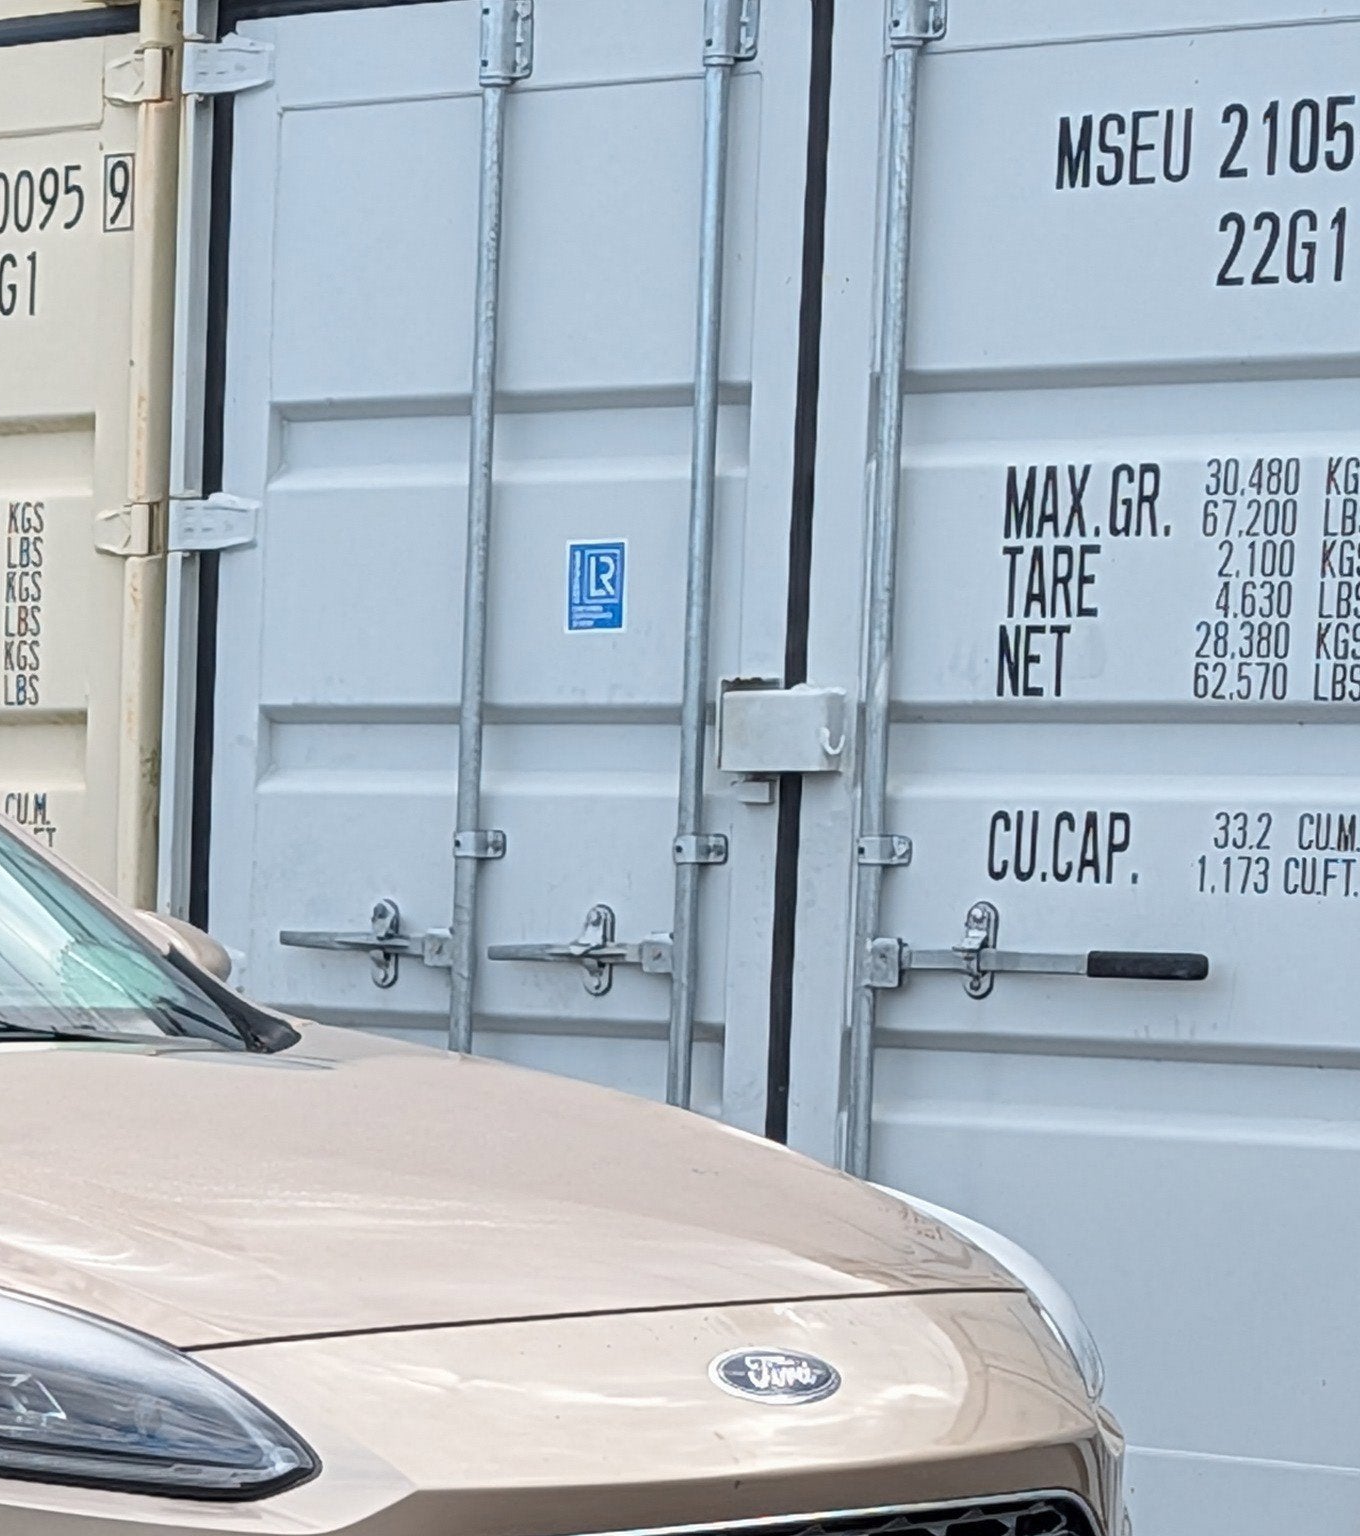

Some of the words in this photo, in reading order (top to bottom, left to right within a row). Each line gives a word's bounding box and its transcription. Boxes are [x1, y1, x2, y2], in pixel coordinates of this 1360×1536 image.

[1055, 107, 1193, 190] MSEU
[1219, 94, 1356, 179] 2105
[107, 157, 132, 228] 9
[1216, 206, 1347, 286] 22G1
[7, 501, 45, 534] KGS
[1323, 498, 1360, 537] LB
[6, 536, 44, 569] LBS
[5, 570, 43, 604] KGS
[1001, 543, 1102, 619] TARE
[4, 605, 41, 637] LBS
[3, 640, 40, 672] KGS
[996, 623, 1072, 697] NET
[3, 673, 40, 706] LBS
[1213, 811, 1272, 850] 33.2
